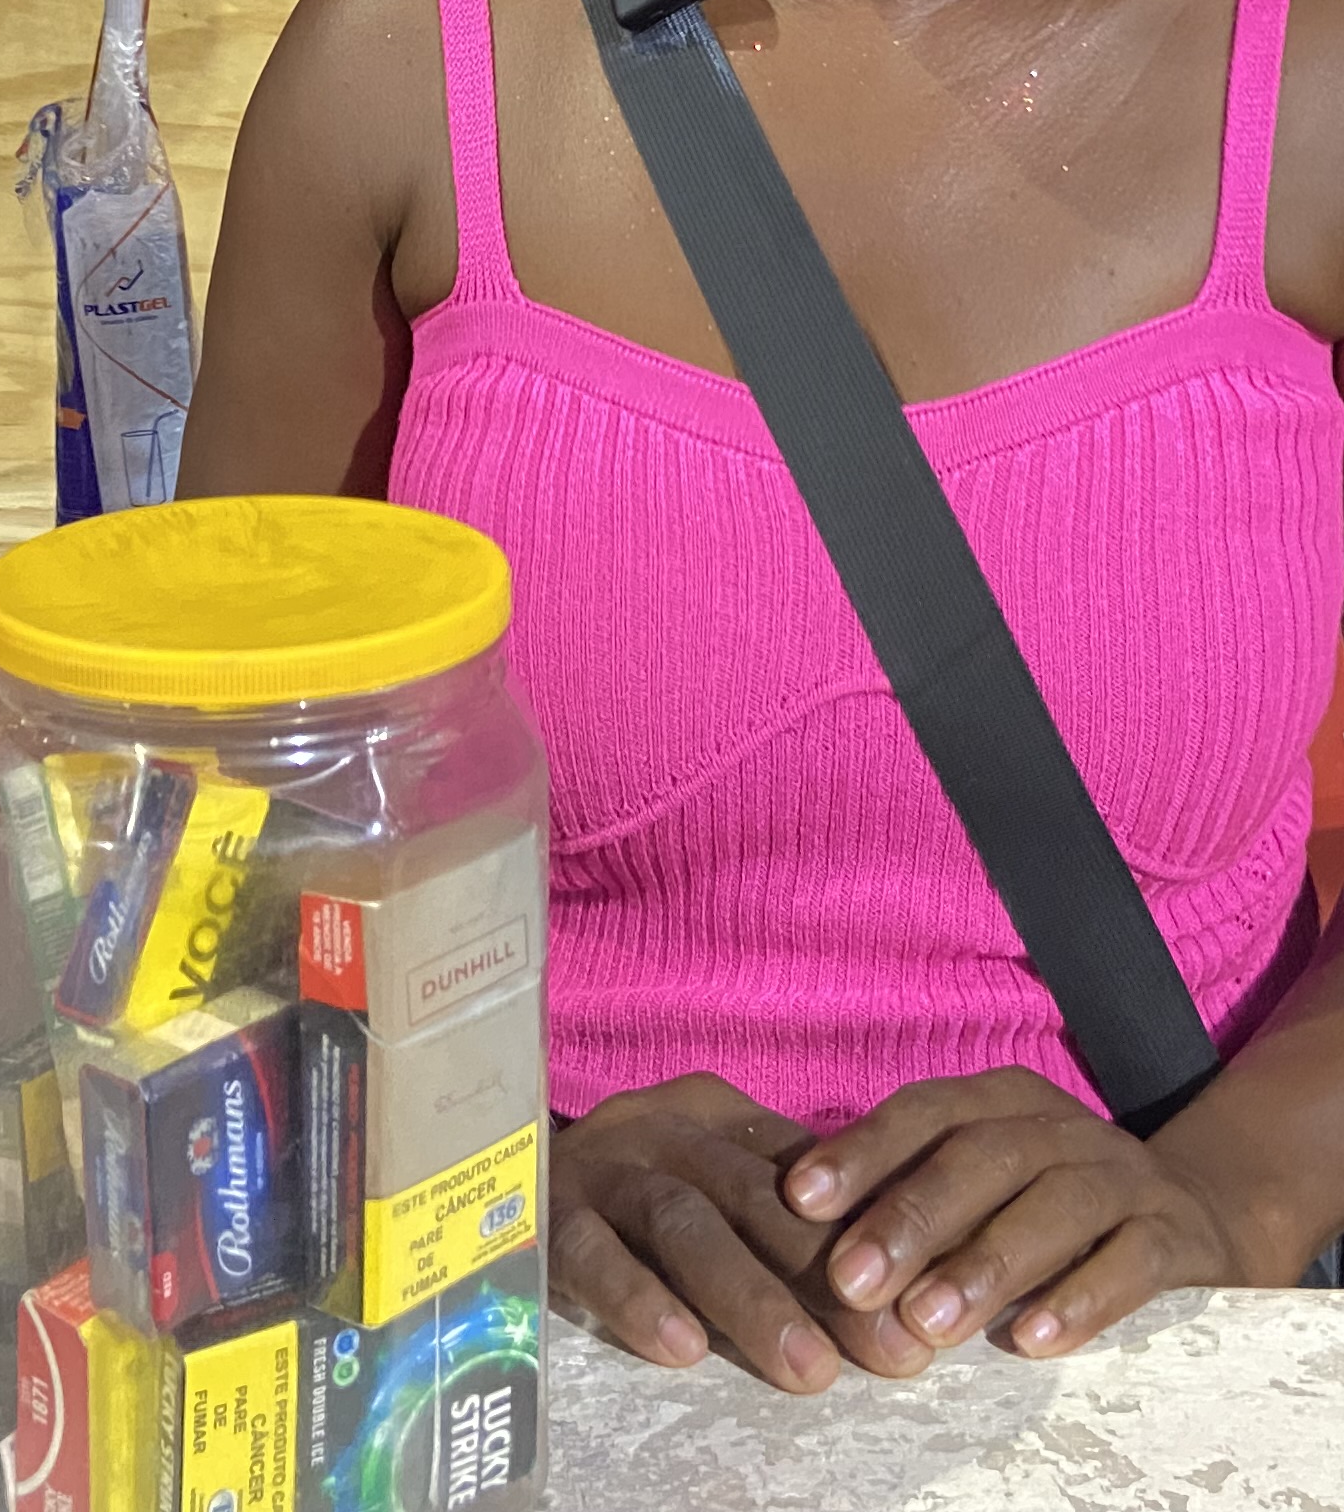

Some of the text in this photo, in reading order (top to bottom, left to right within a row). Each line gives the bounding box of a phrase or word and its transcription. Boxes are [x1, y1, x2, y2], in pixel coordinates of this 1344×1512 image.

[84, 296, 173, 317] PLASTGEL
[169, 830, 259, 1007] VOCÊ
[420, 940, 516, 1001] DUNHILL
[216, 1079, 253, 1277] Rothmans
[392, 1188, 428, 1218] ESTE
[430, 1156, 492, 1201] PRODUTO
[493, 1132, 534, 1166] CAUSA
[434, 1176, 497, 1223] CÂNCER
[408, 1226, 444, 1252] PARE
[486, 1199, 518, 1232] 136
[401, 1265, 449, 1302] FUMAR
[416, 1252, 435, 1273] DE
[31, 1375, 50, 1425] 1871
[160, 1352, 178, 1441] LUCKY
[274, 1346, 289, 1396] ESTE
[192, 1388, 208, 1455] FUMAR
[213, 1402, 228, 1430] DE
[233, 1384, 248, 1435] PARE
[310, 1336, 327, 1468] FRESH DOUBLE ICE
[248, 1413, 270, 1506] CÂNCER
[271, 1398, 288, 1487] PRODUTO
[447, 1393, 481, 1510] STRIKE
[480, 1385, 512, 1490] LUCKY
